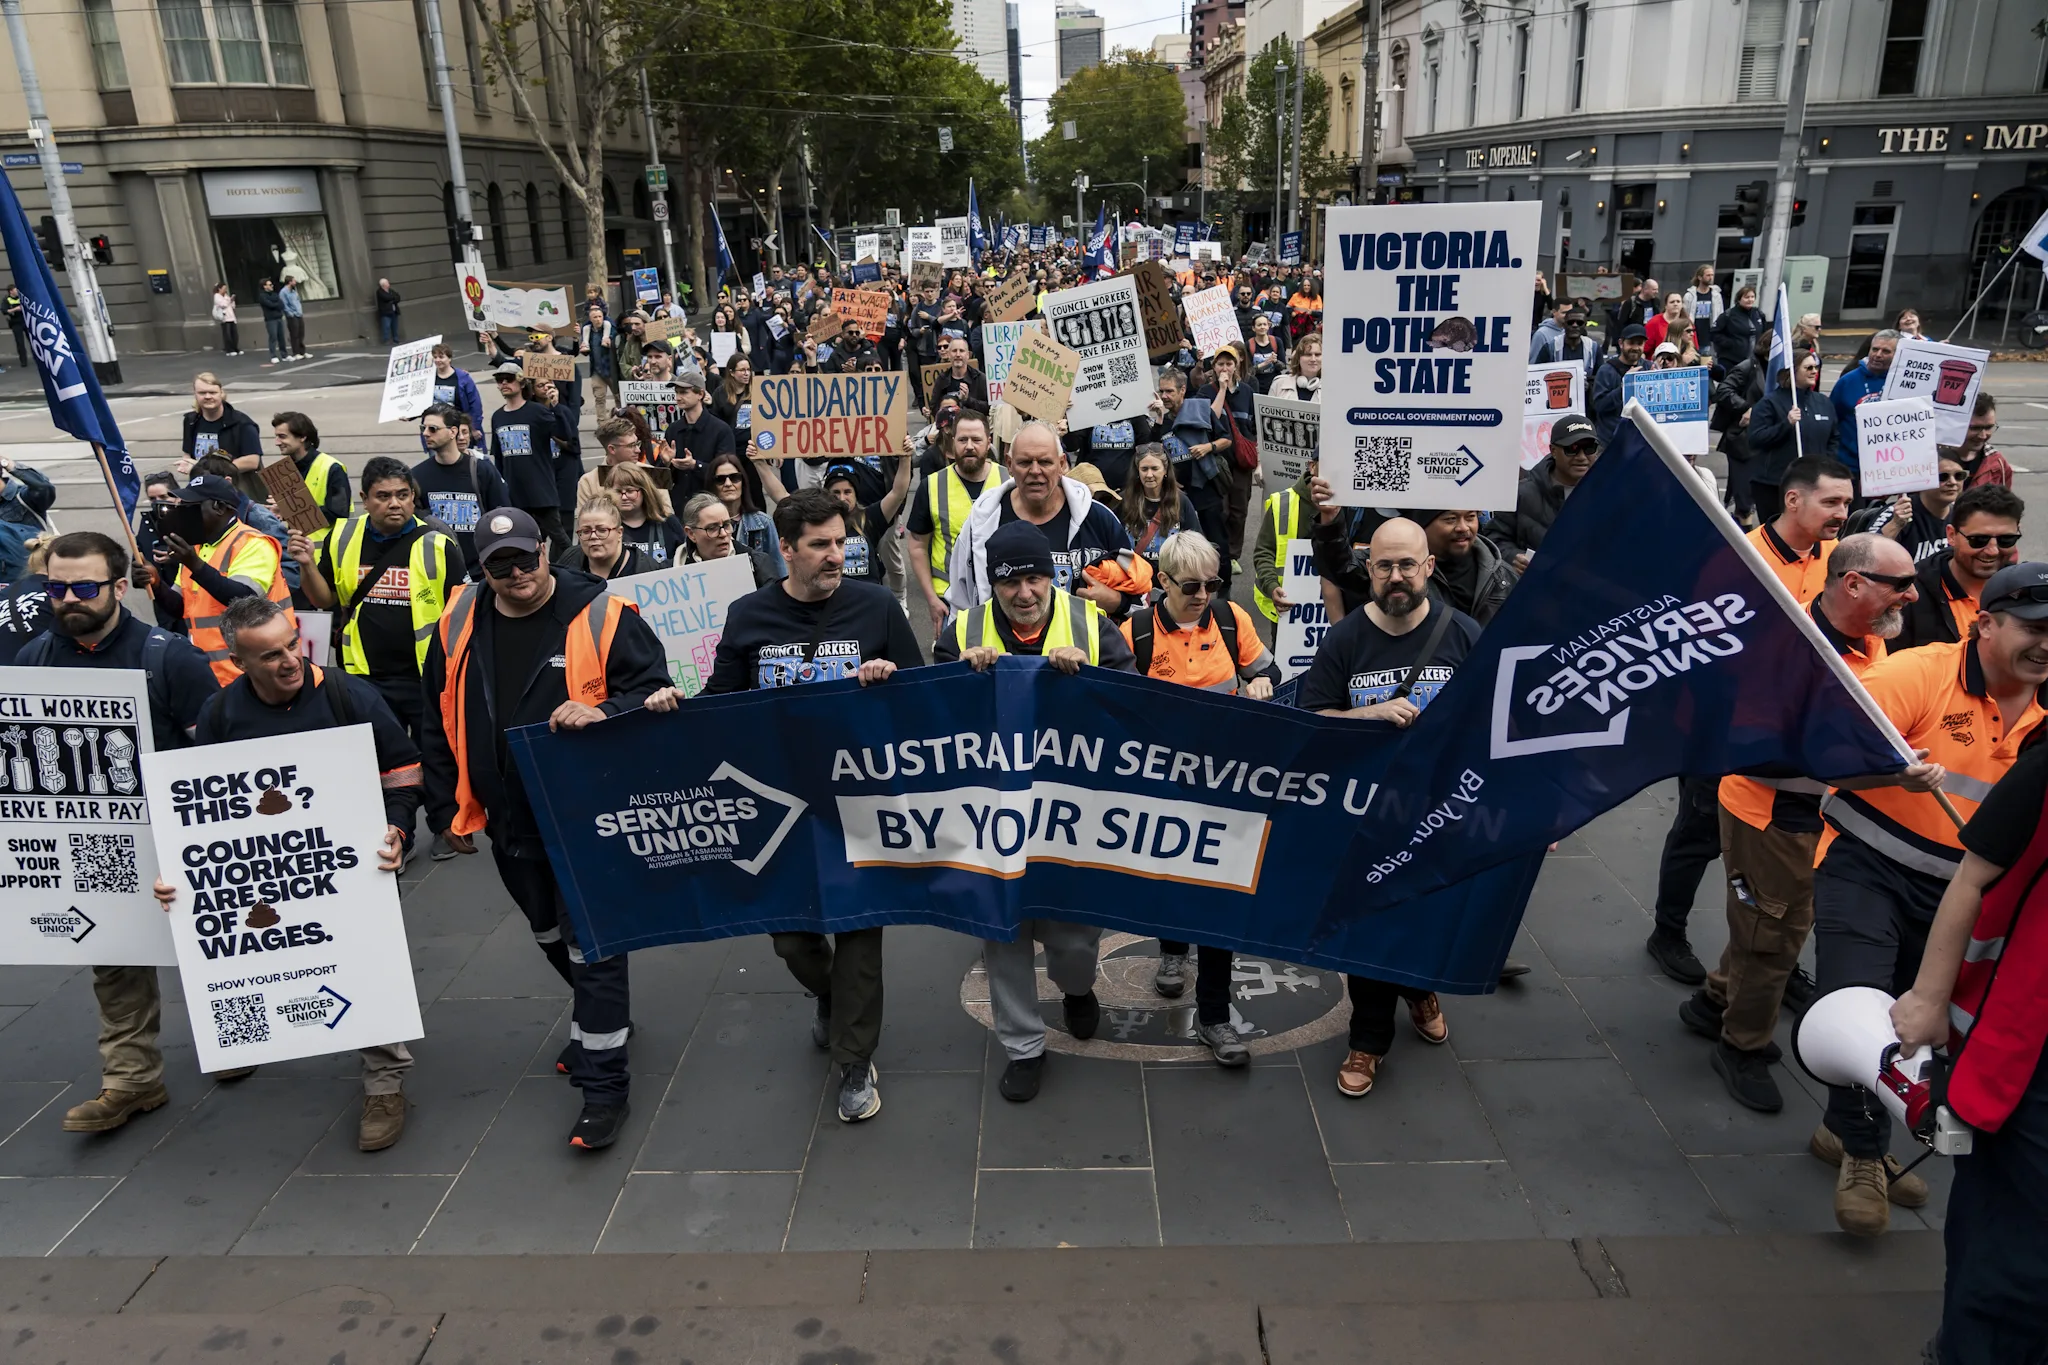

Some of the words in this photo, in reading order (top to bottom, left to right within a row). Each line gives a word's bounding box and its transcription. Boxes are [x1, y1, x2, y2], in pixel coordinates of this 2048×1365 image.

[1878, 127, 1949, 153] THE
[1983, 124, 2048, 150] IMP
[1489, 145, 1532, 167] IMPERIAL
[226, 188, 260, 196] HOTEL
[261, 186, 303, 195] WINDSOR
[655, 205, 667, 215] 40
[1339, 230, 1523, 271] VICTORIA.
[834, 291, 856, 303] FAIR
[860, 293, 888, 309] WAGES
[988, 290, 1009, 307] FAIR
[994, 307, 1003, 317] IS
[1004, 286, 1030, 308] OVERDUE
[1186, 288, 1228, 311] COUNCIL
[1396, 274, 1460, 312] THE
[1052, 299, 1089, 317] COUNCIL
[1092, 290, 1131, 307] WORKERS
[1189, 301, 1231, 323] WORKERS
[837, 306, 852, 315] ARE
[857, 308, 878, 319] LONG
[1147, 317, 1157, 328] IS
[1193, 310, 1236, 333] DESERVE
[1196, 327, 1223, 345] FAIR
[1341, 316, 1512, 354] POTHLE
[1033, 339, 1046, 348] our
[1049, 346, 1061, 360] pay
[1101, 341, 1120, 355] FAIR
[1122, 336, 1138, 349] PAY
[1202, 340, 1221, 353] PAY
[551, 354, 572, 366] work
[1017, 347, 1075, 388] STINKS
[1083, 363, 1104, 374] SHOW
[527, 366, 550, 379] FAIR
[553, 367, 572, 381] PAY
[1016, 371, 1037, 386] worse
[1086, 372, 1106, 382] YOUR
[1374, 357, 1473, 394] STATE
[1635, 373, 1665, 382] COUNCIL
[1667, 370, 1699, 379] WORKERS
[1903, 369, 1931, 382] RATES
[628, 382, 653, 391] MERRI
[1009, 380, 1019, 392] my
[1075, 380, 1107, 393] SUPPORT
[1552, 389, 1565, 397] PAY
[1899, 380, 1917, 389] AND
[1943, 381, 1961, 390] PAY
[626, 393, 657, 402] COUNCIL
[758, 376, 900, 420] SOLIDARITY
[1260, 406, 1295, 419] COUNCIL
[1299, 412, 1320, 422] WORK
[1667, 404, 1684, 412] FAIR
[1685, 402, 1699, 410] PAY
[1353, 412, 1378, 420] FUND
[1378, 412, 1408, 421] LOCAL
[1408, 412, 1468, 422] GOVERNMENT
[1468, 413, 1495, 422] NOW!
[1863, 417, 1882, 428] NO
[782, 416, 893, 454] FOREVER
[1867, 427, 1927, 445] WORKERS
[1264, 443, 1298, 456] DESERVE
[1301, 449, 1313, 458] FAI
[1876, 446, 1905, 463] NO
[1417, 457, 1469, 466] SERVICES
[1424, 465, 1460, 475] UNION
[1864, 462, 1937, 483] MELBOURNE
[282, 487, 307, 513] US
[287, 504, 322, 535] YET?
[634, 573, 707, 609] DON'T
[370, 597, 388, 605] LOCAL
[653, 600, 724, 639] HELVE
[761, 645, 805, 659] COUNCIL
[1350, 671, 1397, 688] COUNCIL
[0, 697, 32, 717] CIL
[41, 698, 133, 719] WORKERS
[66, 733, 81, 741] STOP
[831, 727, 1104, 782] AUSTRALIAN
[1114, 739, 1330, 806] SERVICES
[170, 771, 252, 803] SICK
[254, 765, 297, 791] OF
[629, 786, 715, 806] AUSTRALIAN
[0, 800, 47, 818] ERVE
[56, 801, 101, 819] FAIR
[108, 802, 144, 820] PAY
[173, 796, 252, 827] THIS
[295, 786, 314, 810] ?
[595, 797, 758, 837] SERVICES
[627, 823, 740, 856] UNION
[876, 807, 944, 849] BY
[961, 797, 1082, 857] YOUR
[1096, 807, 1227, 865] SIDE
[8, 838, 57, 853] SHOW
[182, 826, 333, 868] COUNCIL
[644, 851, 683, 863] VICTORIAN
[690, 846, 732, 856] TASMANIAN
[648, 857, 693, 869] AUTHORITIES
[700, 852, 733, 861] SERVICES
[15, 856, 60, 871] YOUR
[184, 846, 359, 890] WORKERS
[0, 875, 61, 889] UPPORT
[192, 885, 256, 915] ARE
[258, 872, 338, 904] SICK
[30, 917, 81, 925] SERVICES
[39, 925, 74, 933] UNION
[195, 911, 238, 937] OF
[198, 922, 333, 960] WAGES.
[207, 978, 245, 993] SHOW
[247, 973, 281, 986] YOUR
[282, 964, 337, 981] SUPPORT
[276, 998, 334, 1015] SERVICES
[288, 995, 319, 1003] AUSTRALIAN
[287, 1009, 327, 1023] UNION
